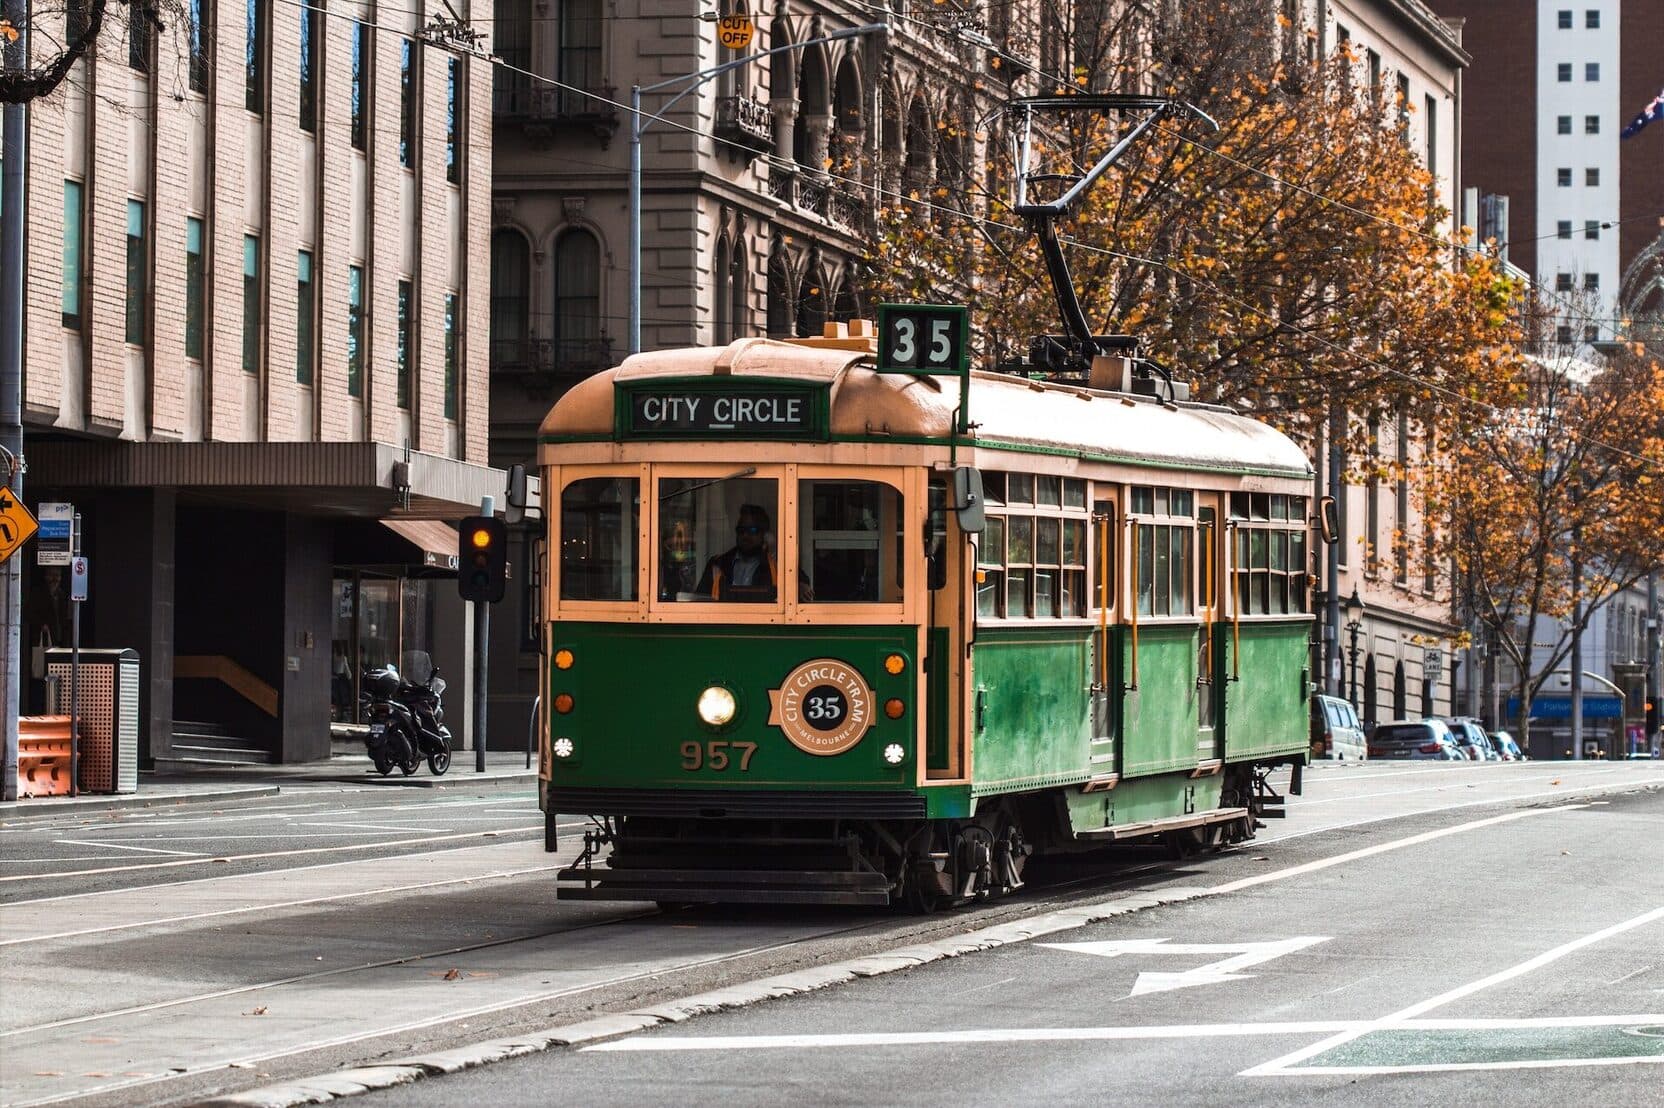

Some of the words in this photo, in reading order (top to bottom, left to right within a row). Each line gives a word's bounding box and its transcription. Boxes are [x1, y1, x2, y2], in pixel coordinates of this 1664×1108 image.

[722, 18, 748, 30] CUT
[722, 32, 749, 44] OFF
[892, 318, 951, 362] 35
[643, 397, 700, 422] CITY
[713, 398, 801, 423] CIRCLE
[785, 687, 799, 722] CITY
[797, 668, 847, 687] CIRCLE
[846, 679, 864, 723] TRAM
[808, 696, 840, 719] 35
[800, 730, 850, 745] MELBOURNE
[680, 741, 758, 770] 957
